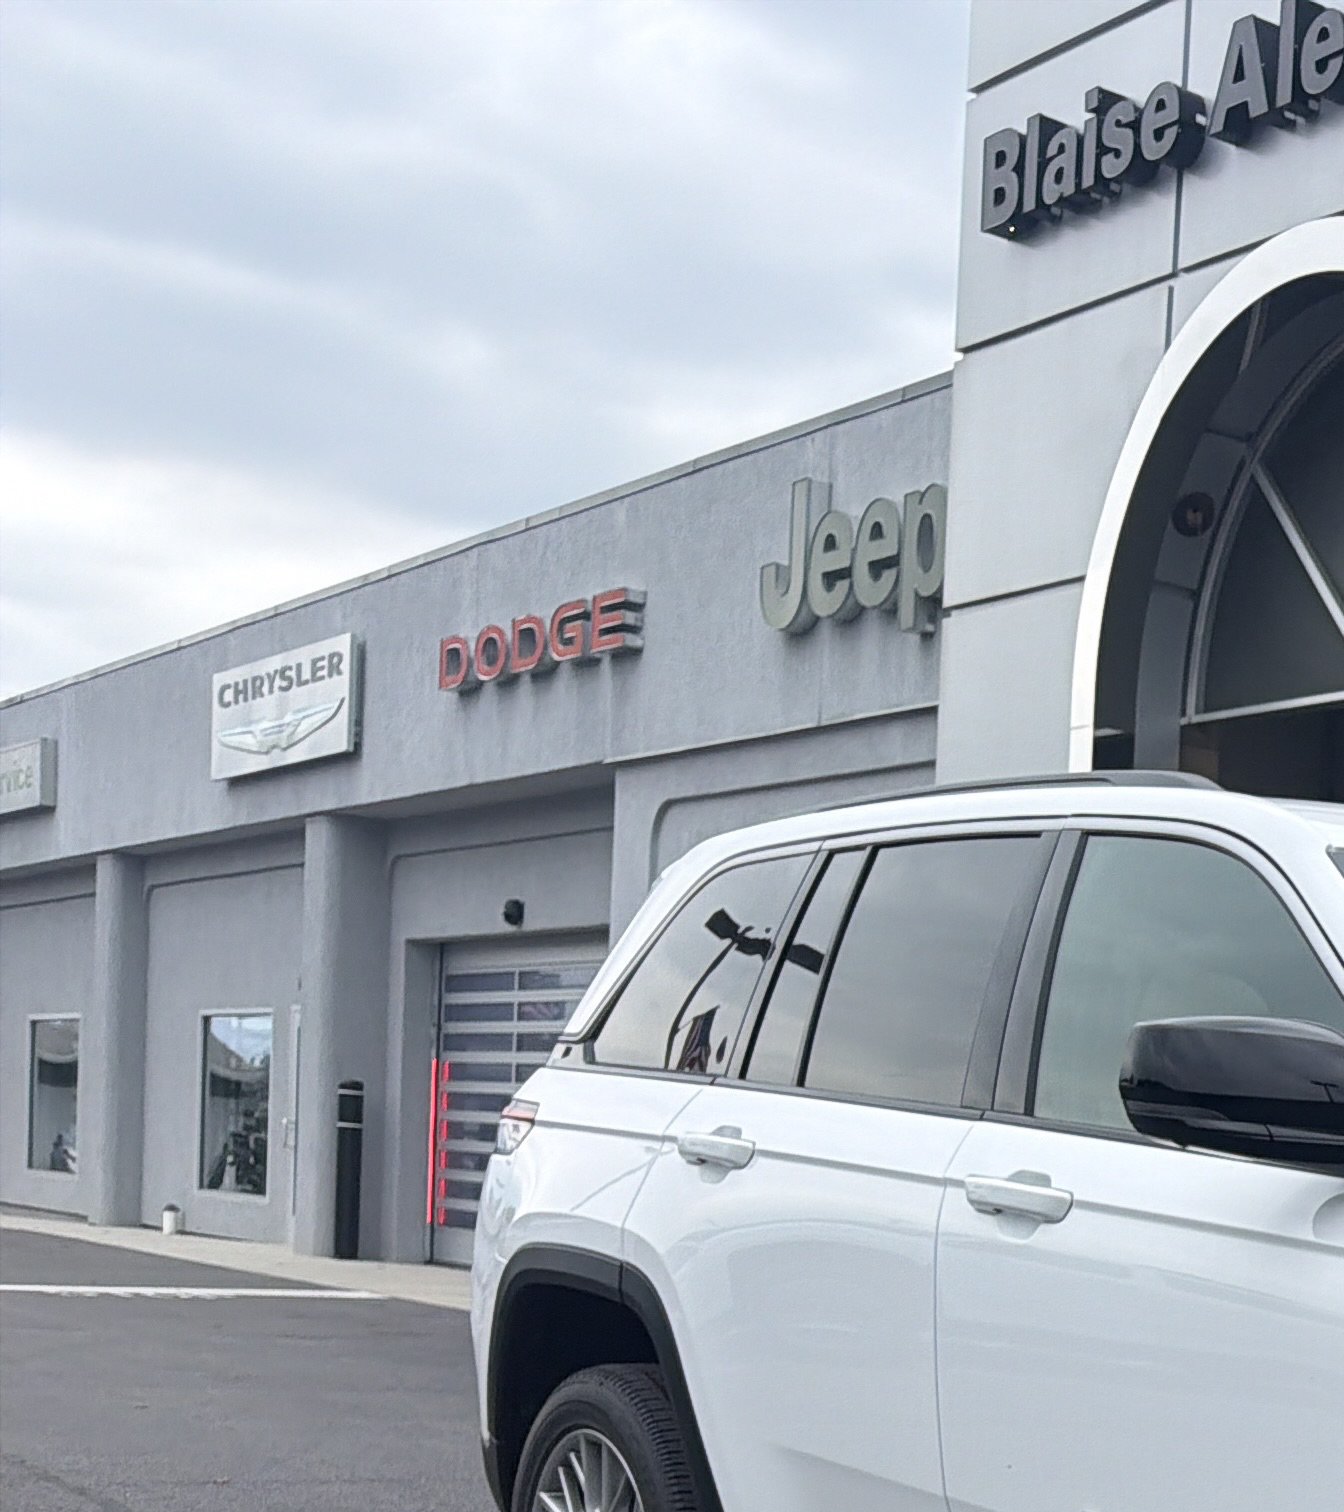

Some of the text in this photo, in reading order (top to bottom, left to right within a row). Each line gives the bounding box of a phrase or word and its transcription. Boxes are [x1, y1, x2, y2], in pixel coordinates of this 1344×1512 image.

[981, 80, 1184, 232] Blaise
[760, 476, 949, 633] Jeep
[217, 651, 345, 709] CHRYSLER
[438, 586, 632, 692] DODGE
